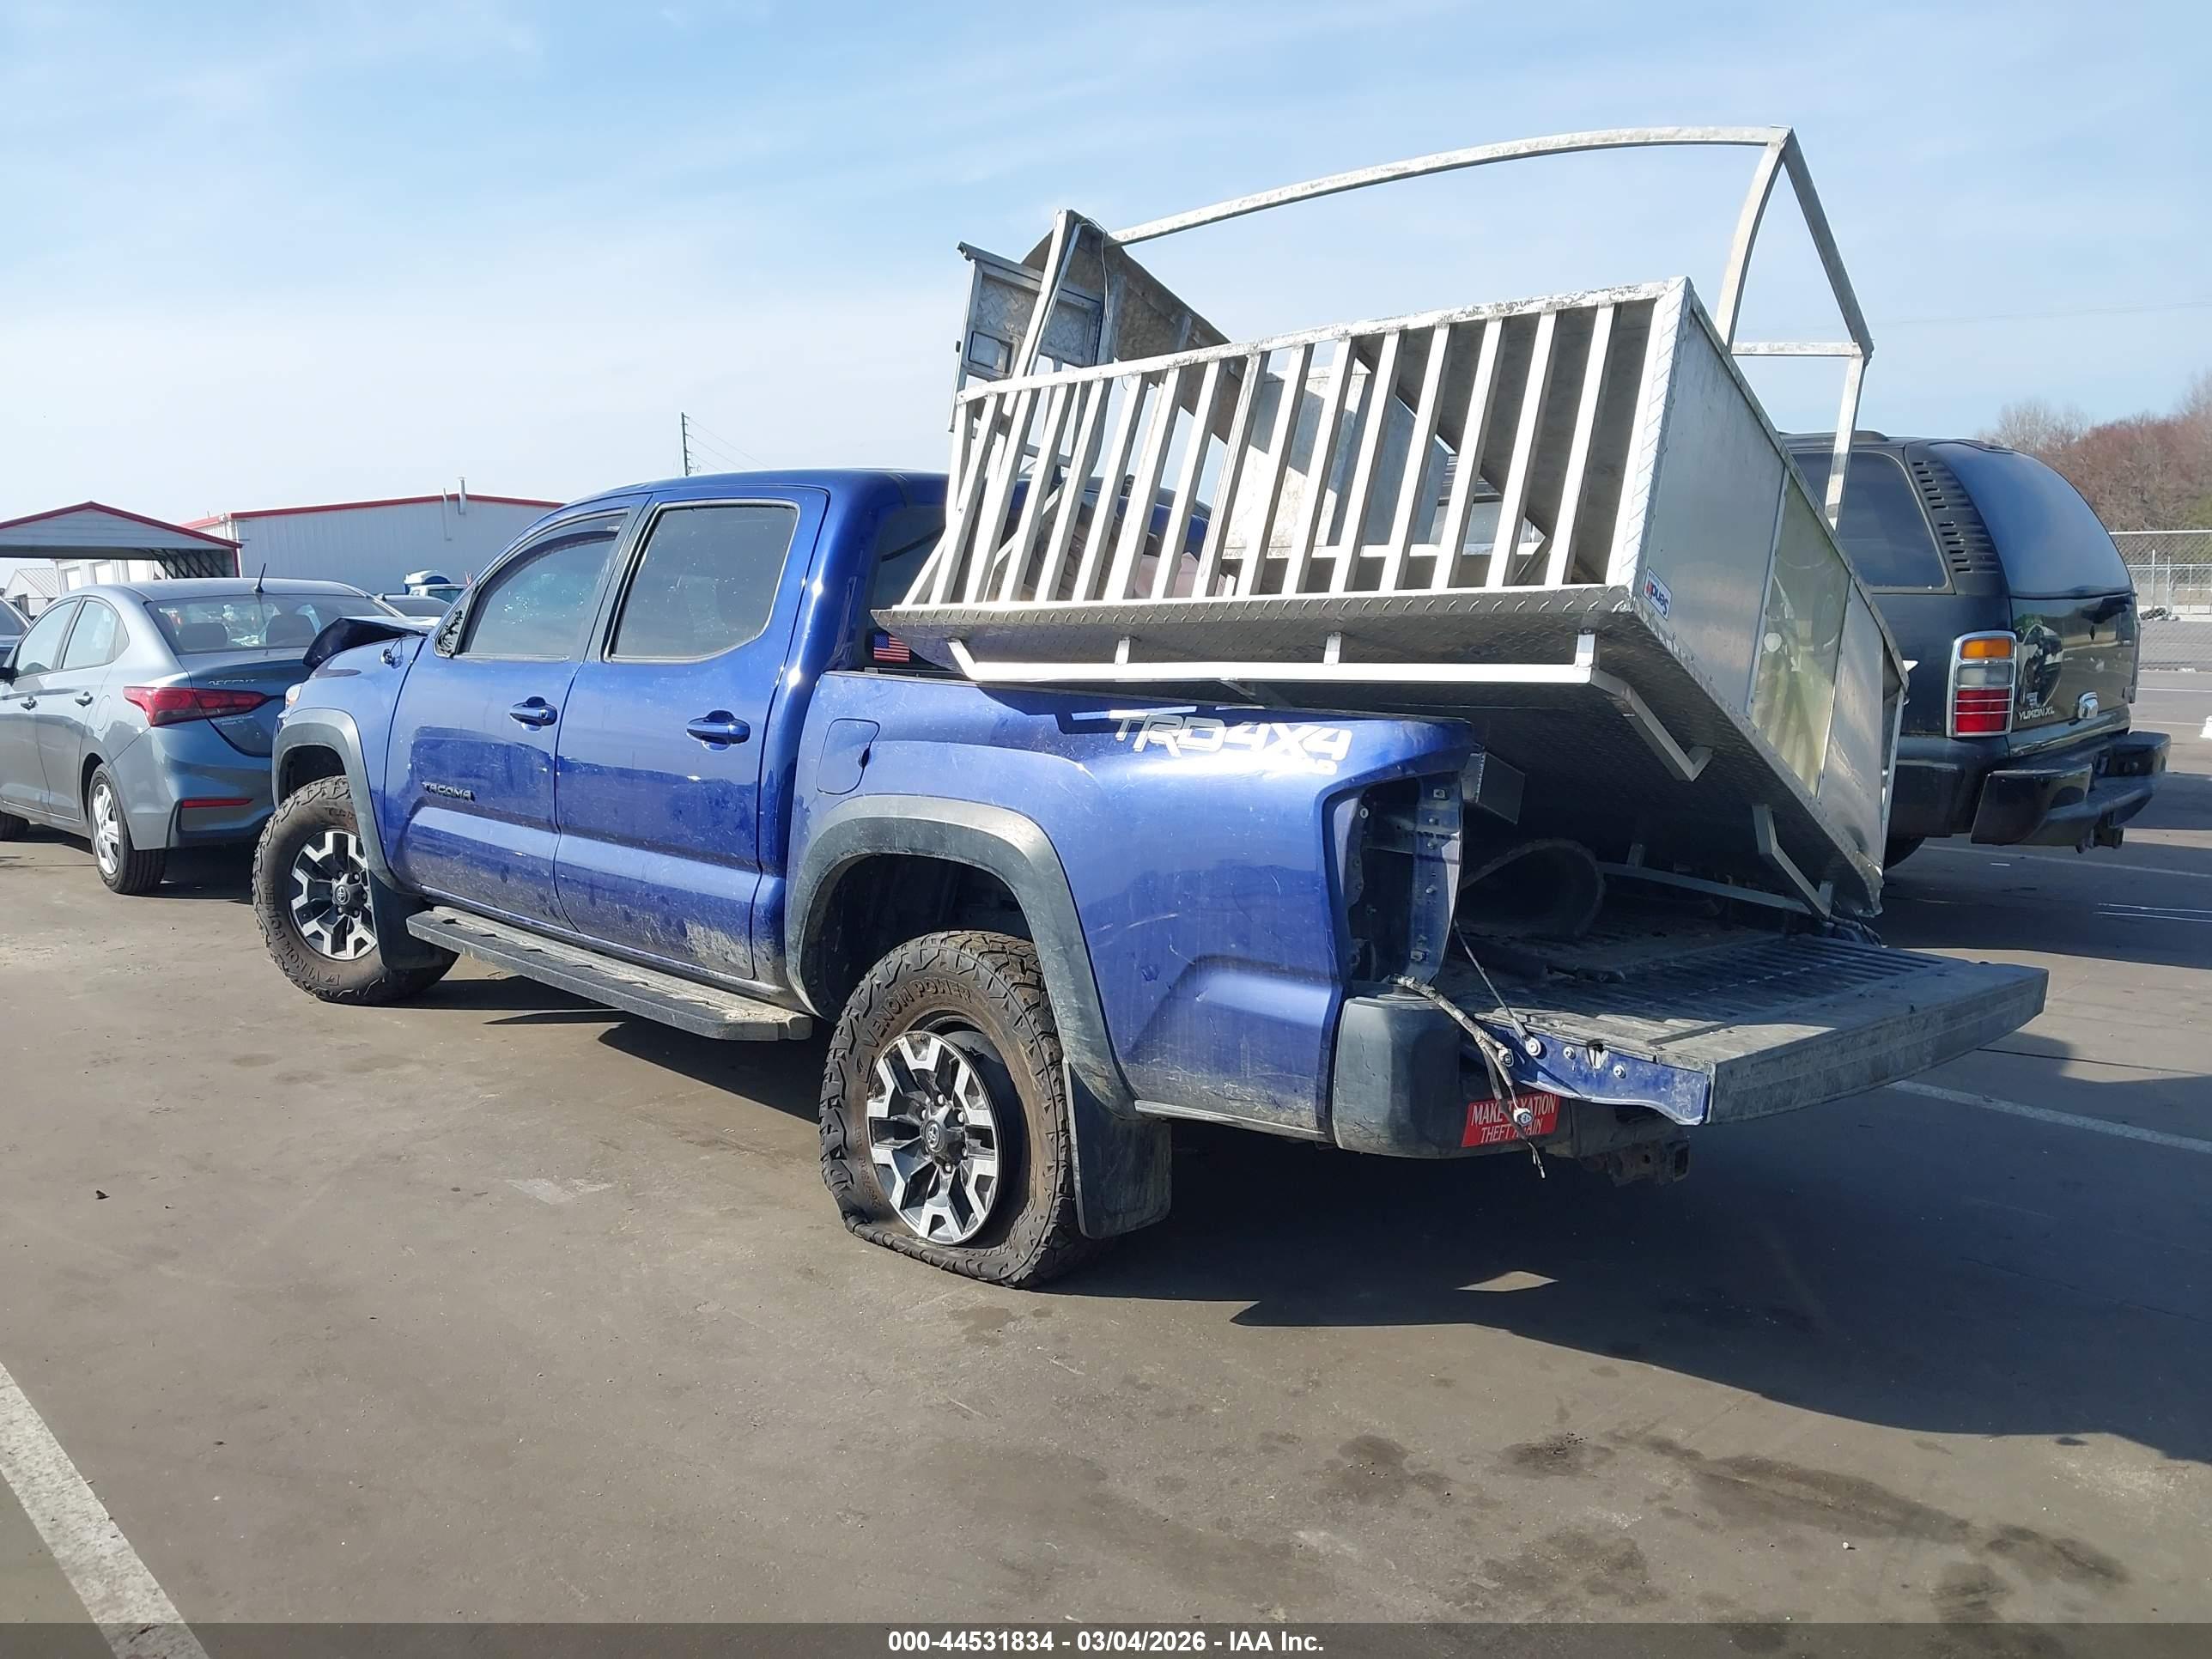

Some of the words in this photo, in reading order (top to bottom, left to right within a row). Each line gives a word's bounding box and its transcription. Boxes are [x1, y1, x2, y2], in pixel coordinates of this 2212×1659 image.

[2019, 708, 2044, 721] YUKON
[2045, 706, 2055, 715] XL
[422, 781, 474, 801] TACOMA
[862, 986, 915, 1048] VENOM
[909, 977, 972, 1004] POWER
[1507, 1094, 1557, 1118] TXATION
[1480, 1122, 1512, 1144] THEFT
[1511, 1118, 1543, 1139] AAIN
